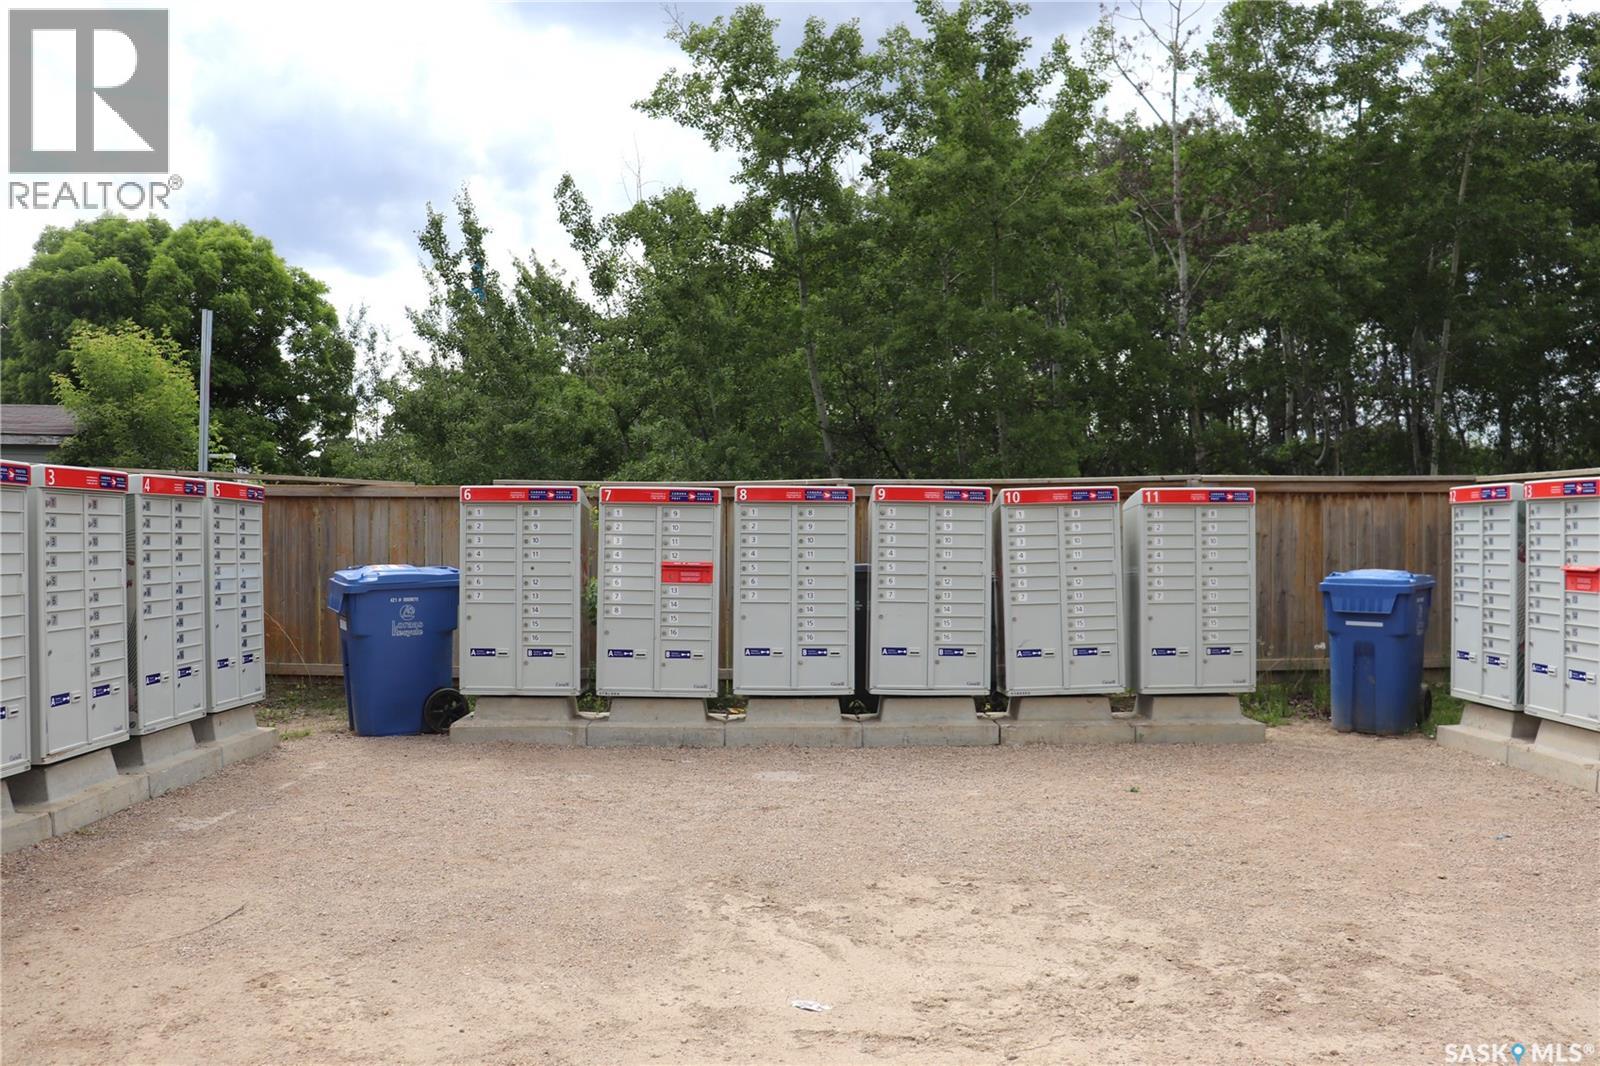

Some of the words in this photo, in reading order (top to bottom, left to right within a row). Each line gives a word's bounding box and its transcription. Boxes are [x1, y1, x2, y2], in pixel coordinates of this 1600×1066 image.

[48, 469, 55, 485] 3
[144, 478, 150, 491] 4
[215, 484, 220, 496] 5
[464, 489, 471, 500] 6
[604, 490, 611, 501] 7
[740, 489, 747, 500] 8
[878, 488, 885, 500] 9
[1005, 492, 1020, 503] 10
[1145, 491, 1158, 502] 11
[1450, 490, 1456, 502] 12
[1524, 485, 1533, 498] 13
